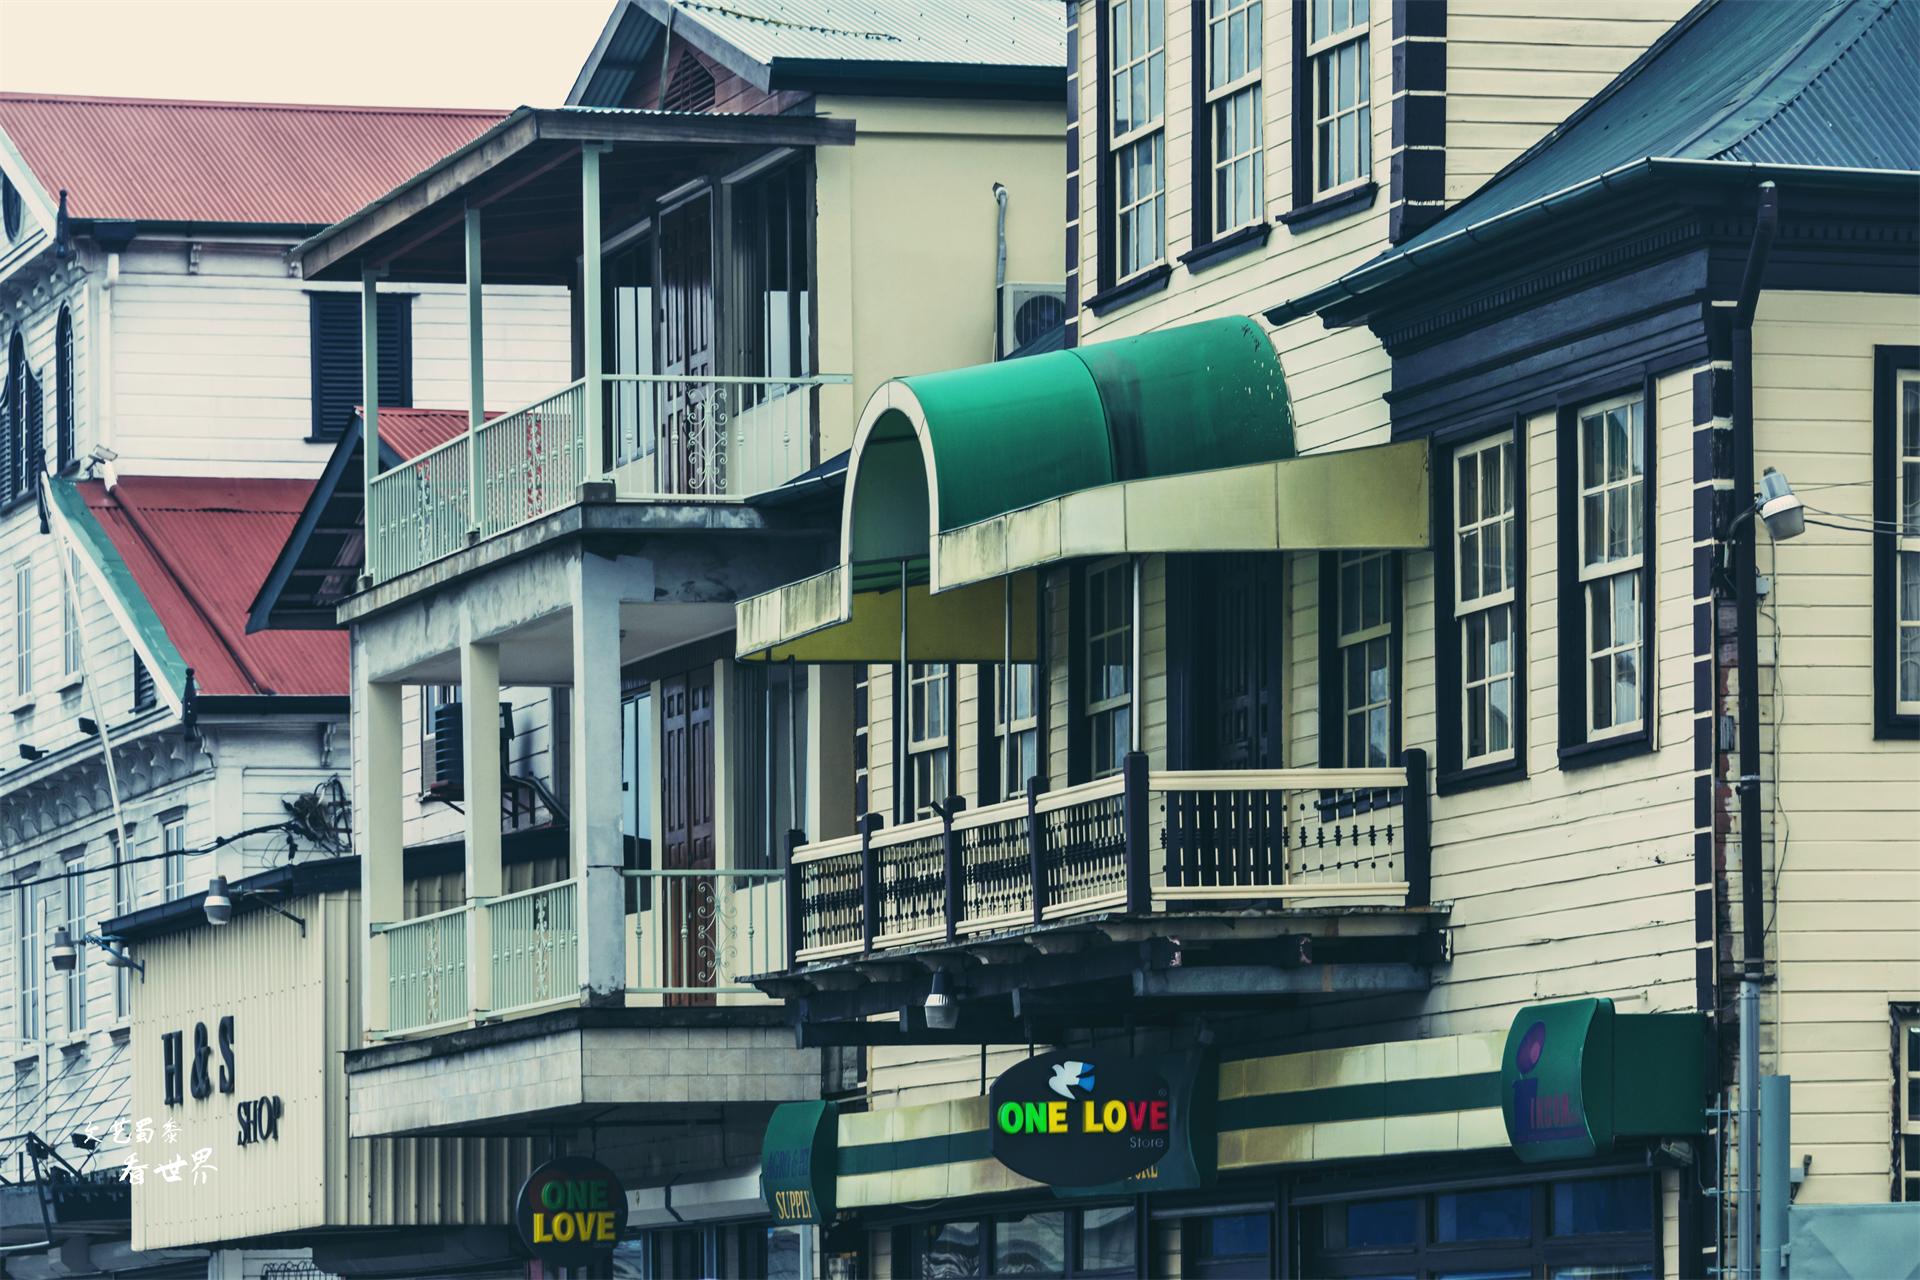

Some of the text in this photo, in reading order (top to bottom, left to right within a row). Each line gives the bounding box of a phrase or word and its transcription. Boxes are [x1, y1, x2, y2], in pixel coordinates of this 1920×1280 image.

[237, 1095, 281, 1146] SHOP
[997, 1099, 1169, 1134] ONE LOVE
[1129, 1136, 1164, 1148] Store
[541, 1180, 609, 1210] ONE
[775, 1190, 812, 1219] SUPPLY
[533, 1211, 616, 1243] LOVE
